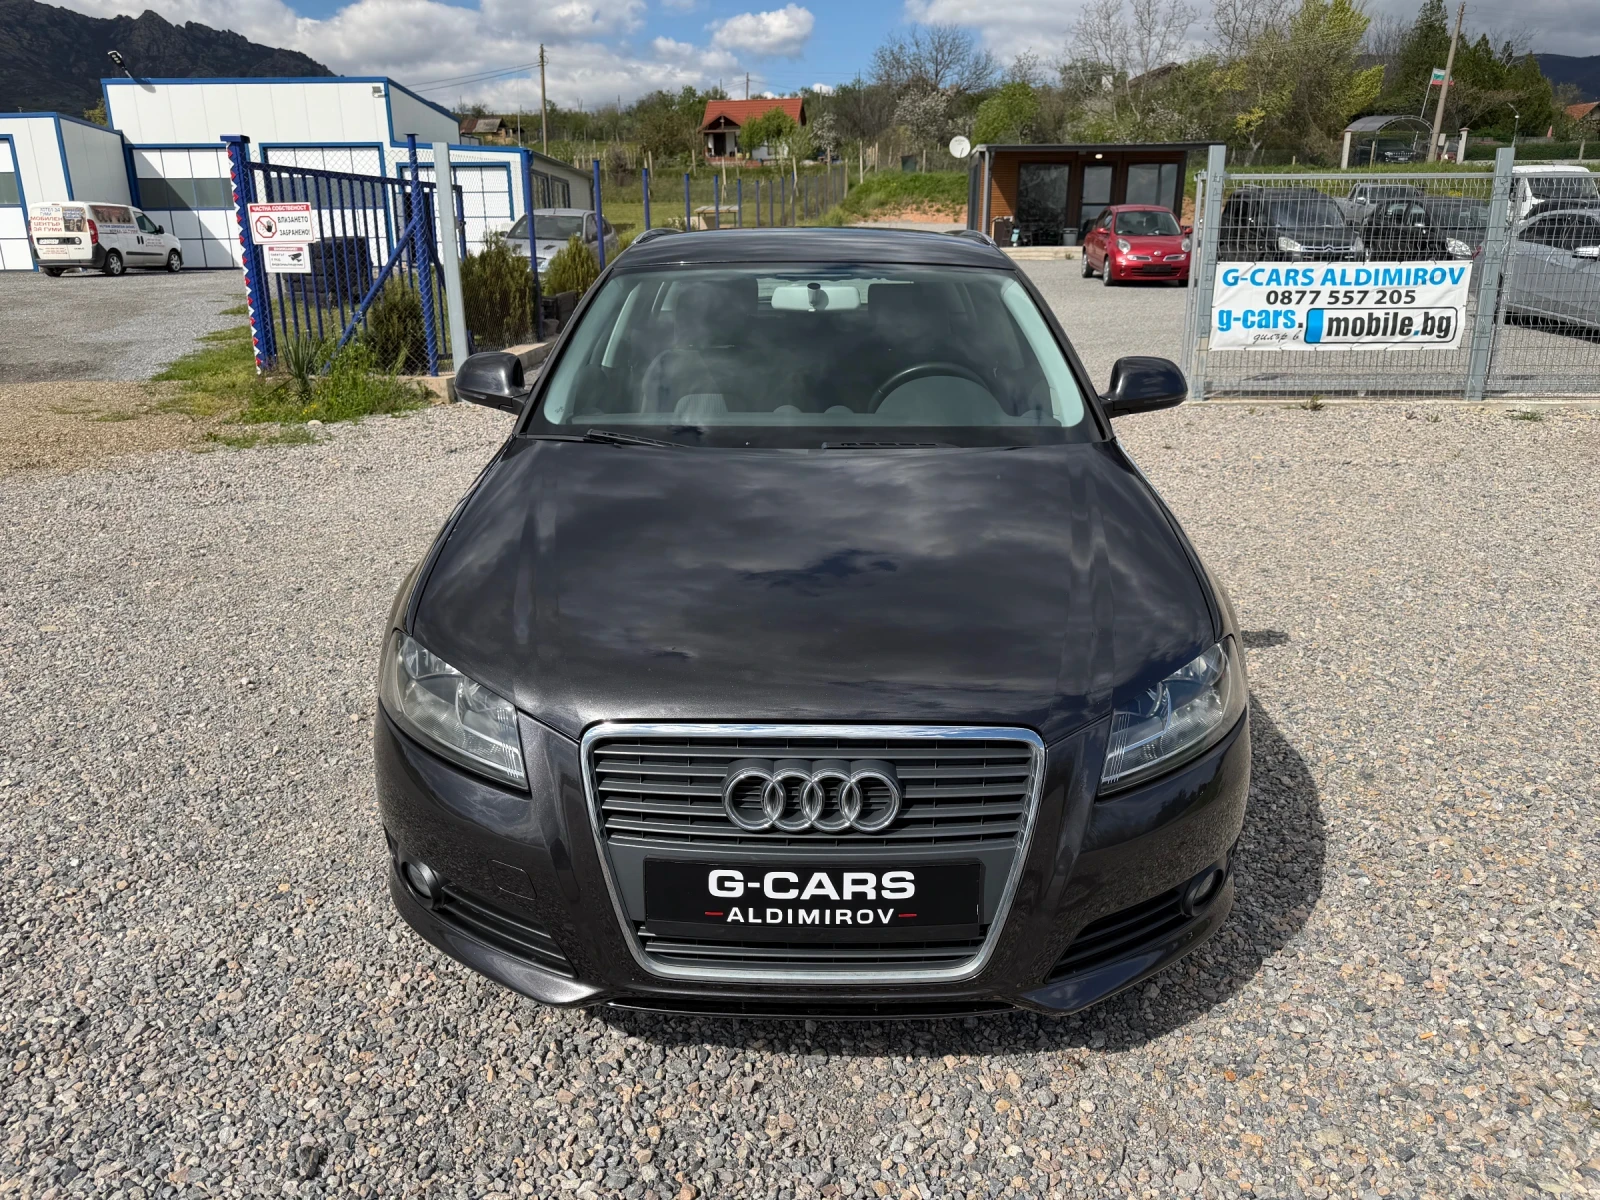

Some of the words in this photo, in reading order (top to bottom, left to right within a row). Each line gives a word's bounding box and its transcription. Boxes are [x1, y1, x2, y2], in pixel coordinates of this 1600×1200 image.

[1222, 268, 1314, 287] G-CARS
[1320, 267, 1466, 287] ALDIMIROV
[1266, 290, 1321, 305] 0877
[1327, 290, 1370, 305] 557
[1374, 290, 1416, 305] 205
[1218, 309, 1304, 331] g-cars.
[1326, 312, 1452, 338] mobile.bg
[708, 870, 916, 900] G-CARS
[726, 908, 895, 925] ALDIMIROV
